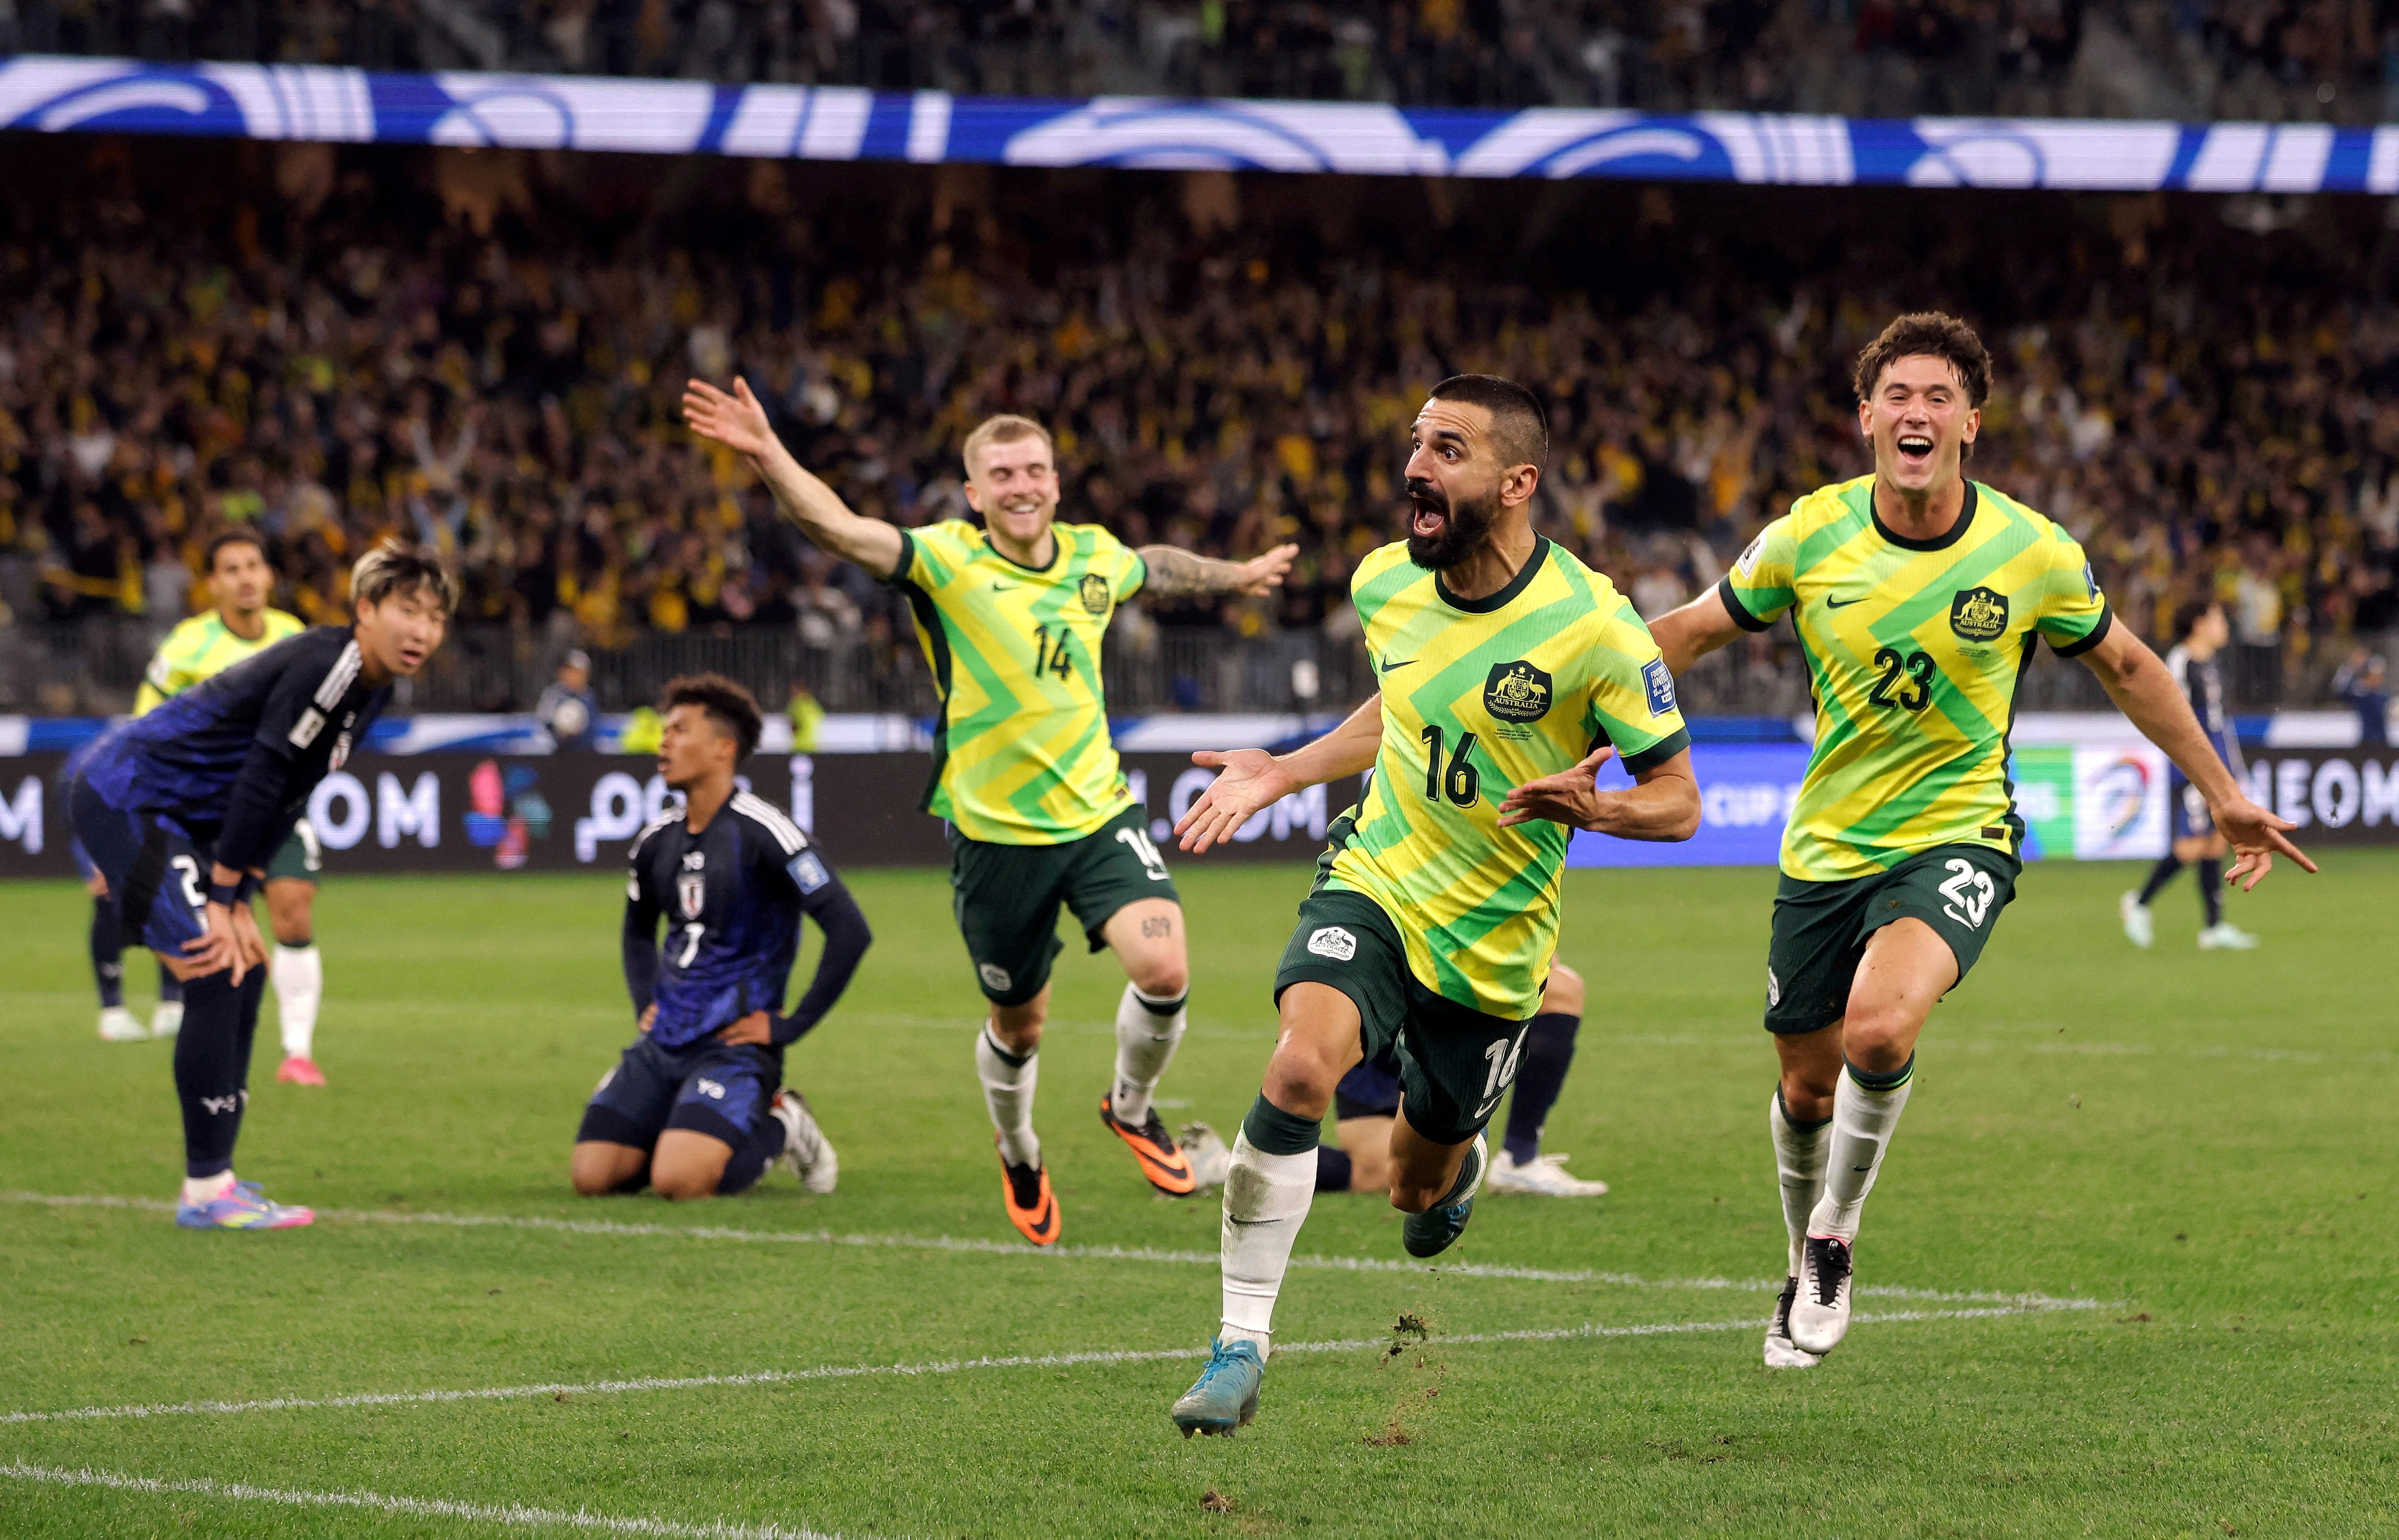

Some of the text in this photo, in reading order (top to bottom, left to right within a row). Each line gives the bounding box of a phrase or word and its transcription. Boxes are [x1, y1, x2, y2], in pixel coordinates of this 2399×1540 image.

[1960, 620, 1996, 629] AUSTRALIA
[1034, 625, 1071, 681] 14
[1494, 697, 1538, 709] AUSTRALIA
[1651, 670, 1668, 688] UNITES
[1652, 687, 1663, 697] the
[1868, 648, 1936, 713] 23
[1422, 724, 1480, 809] 16
[306, 770, 440, 850] OM
[1938, 858, 1995, 928] 23
[677, 922, 705, 969] 7
[1315, 944, 1346, 954] AUSTRALIA
[1483, 1024, 1529, 1099] 16
